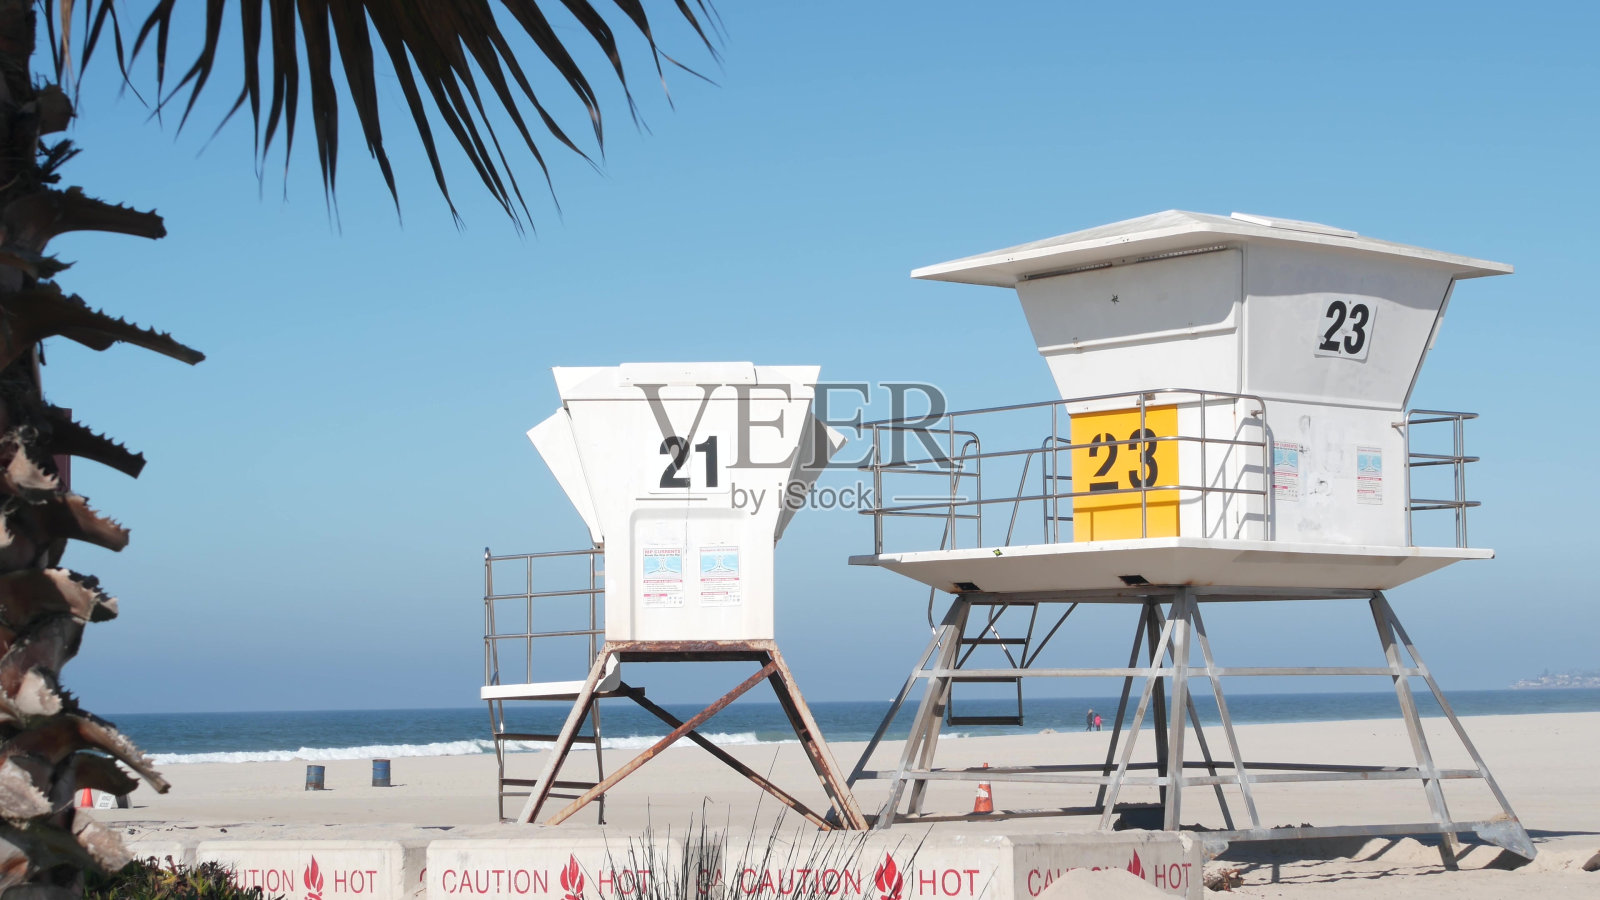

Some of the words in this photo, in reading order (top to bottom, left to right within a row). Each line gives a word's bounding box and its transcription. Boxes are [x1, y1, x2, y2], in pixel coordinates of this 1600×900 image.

[1319, 300, 1369, 354] 23
[659, 435, 718, 488] 21
[1089, 428, 1158, 492] 23
[335, 870, 377, 893] HOT
[442, 869, 548, 894] CAUTION
[599, 869, 652, 895] HOT
[740, 868, 861, 895] CAUTION
[919, 869, 980, 896] HOT
[1155, 863, 1192, 889] HOT
